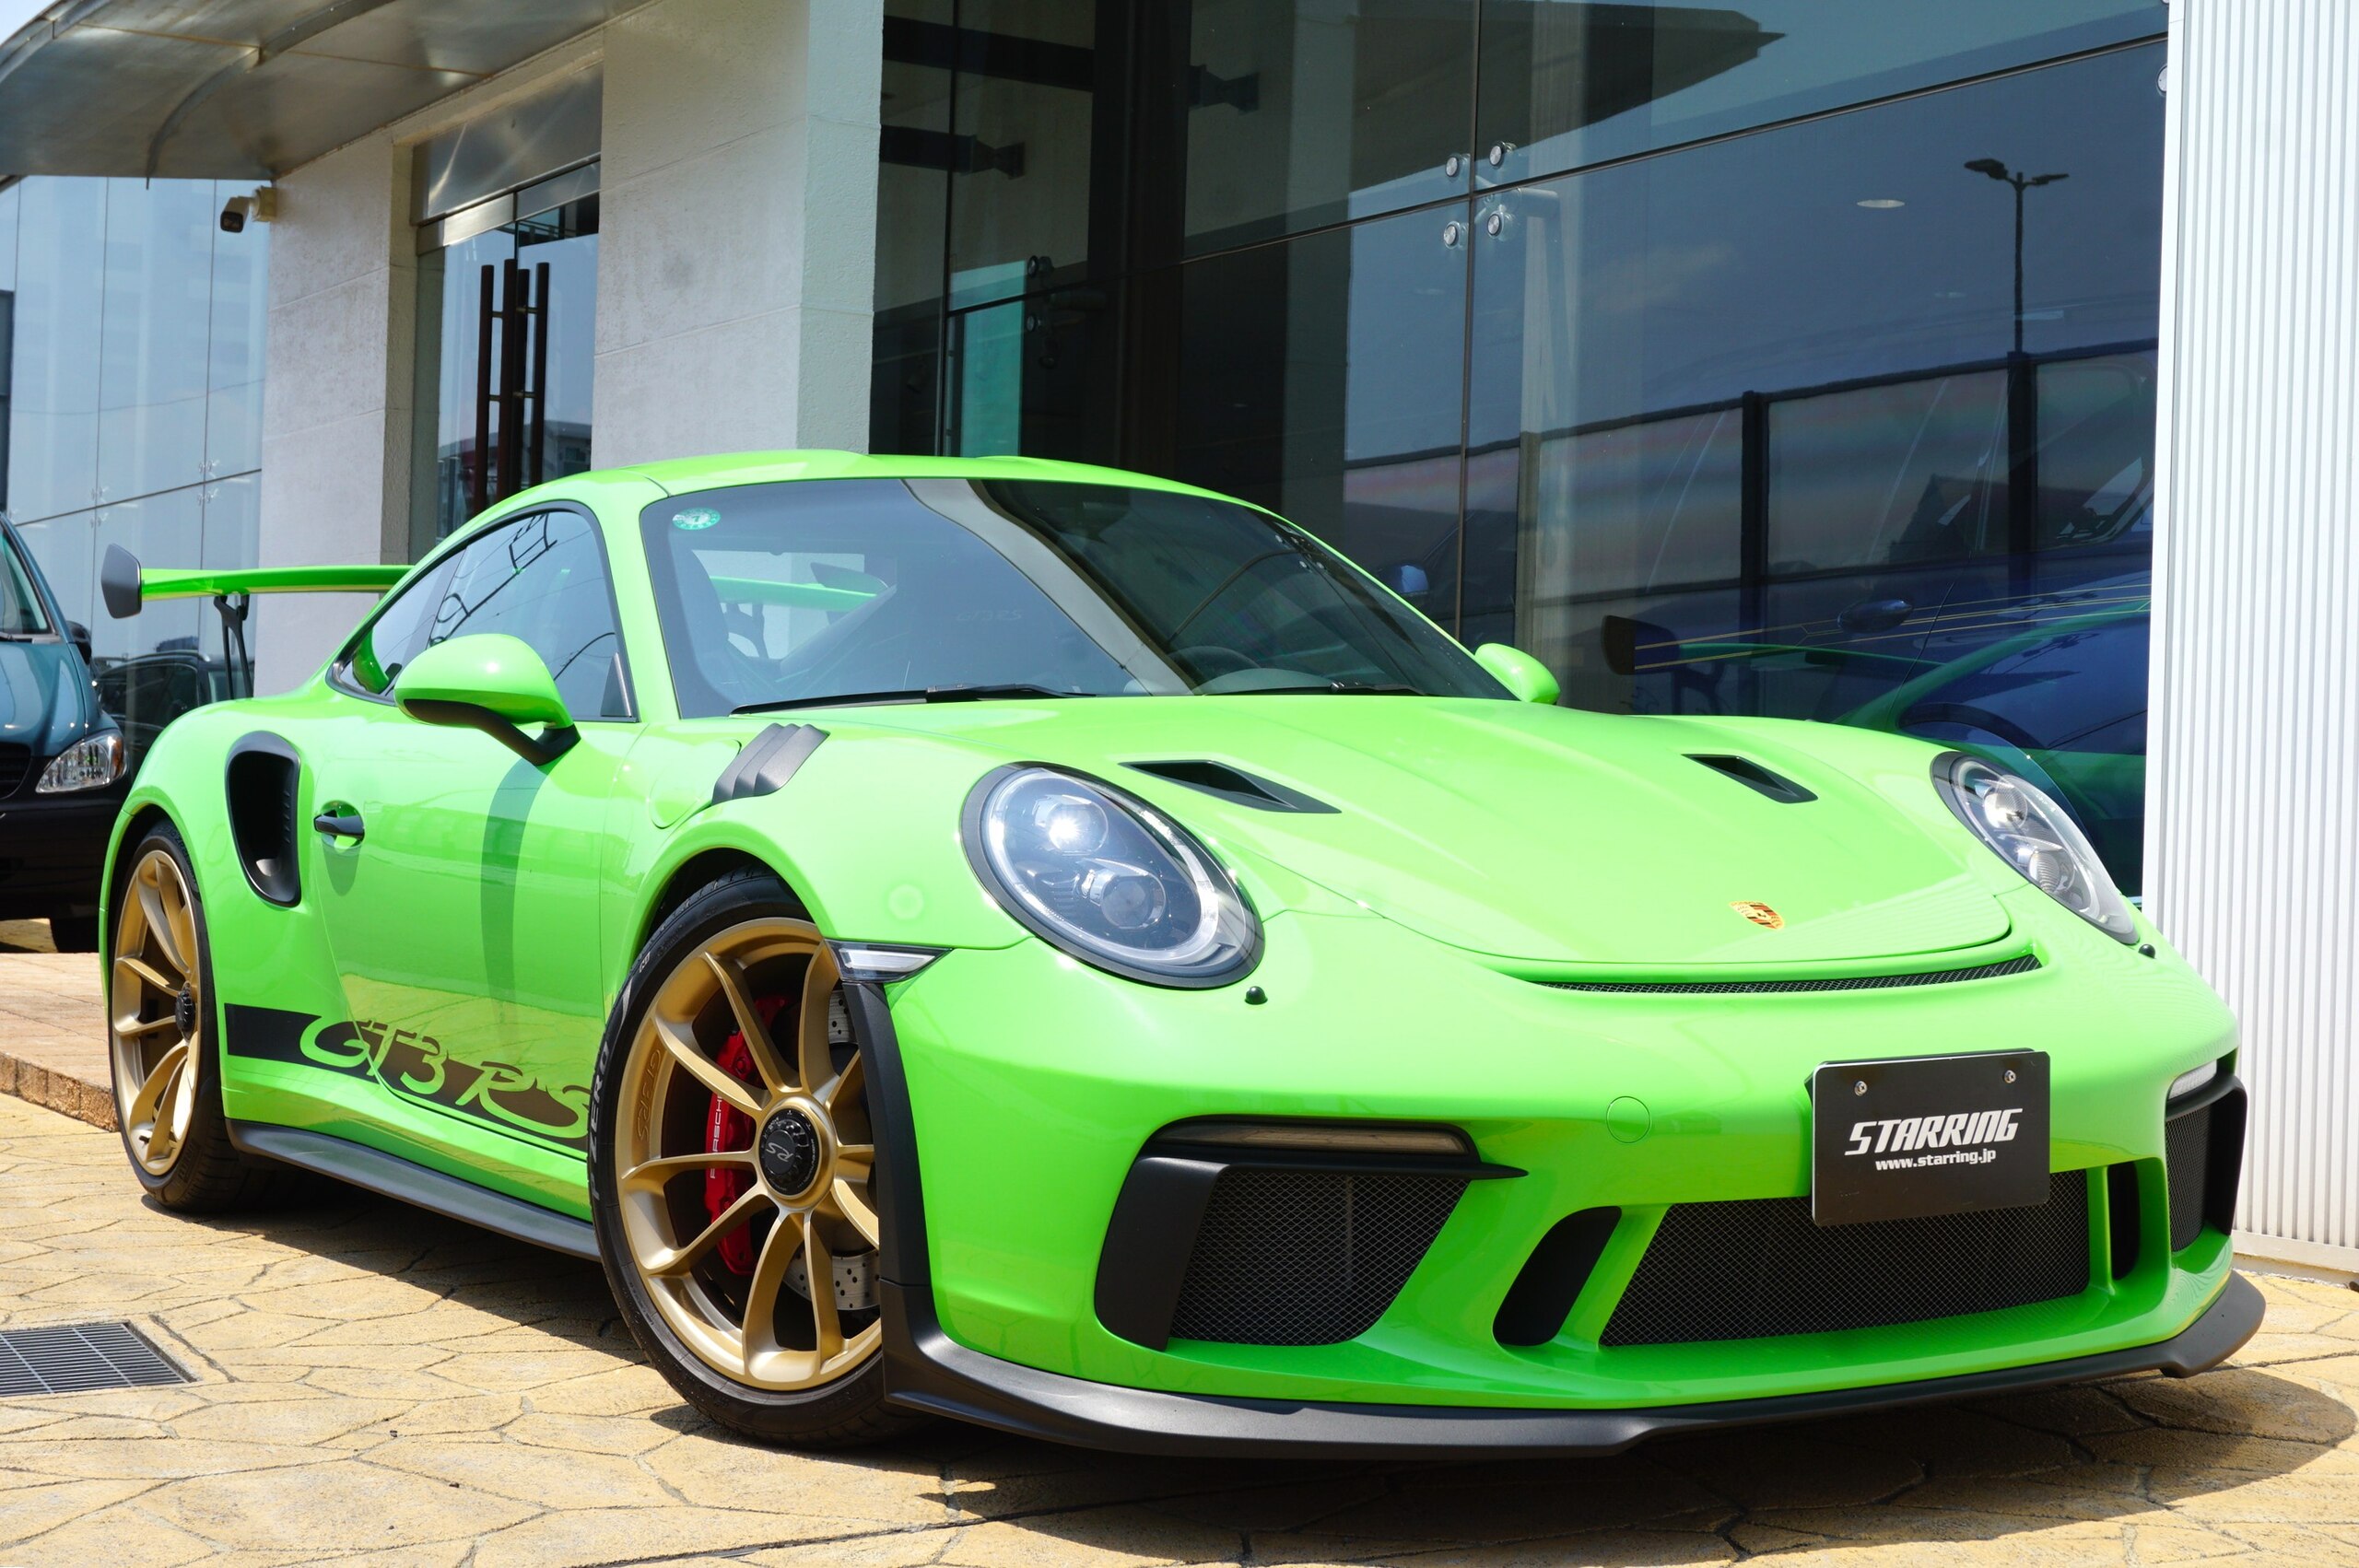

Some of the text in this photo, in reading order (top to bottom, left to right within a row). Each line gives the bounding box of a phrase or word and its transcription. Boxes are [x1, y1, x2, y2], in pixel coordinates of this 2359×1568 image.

[589, 1040, 609, 1164] ZERO
[1844, 1107, 2024, 1156] STARRING
[1874, 1148, 1997, 1171] www.starring.jp
